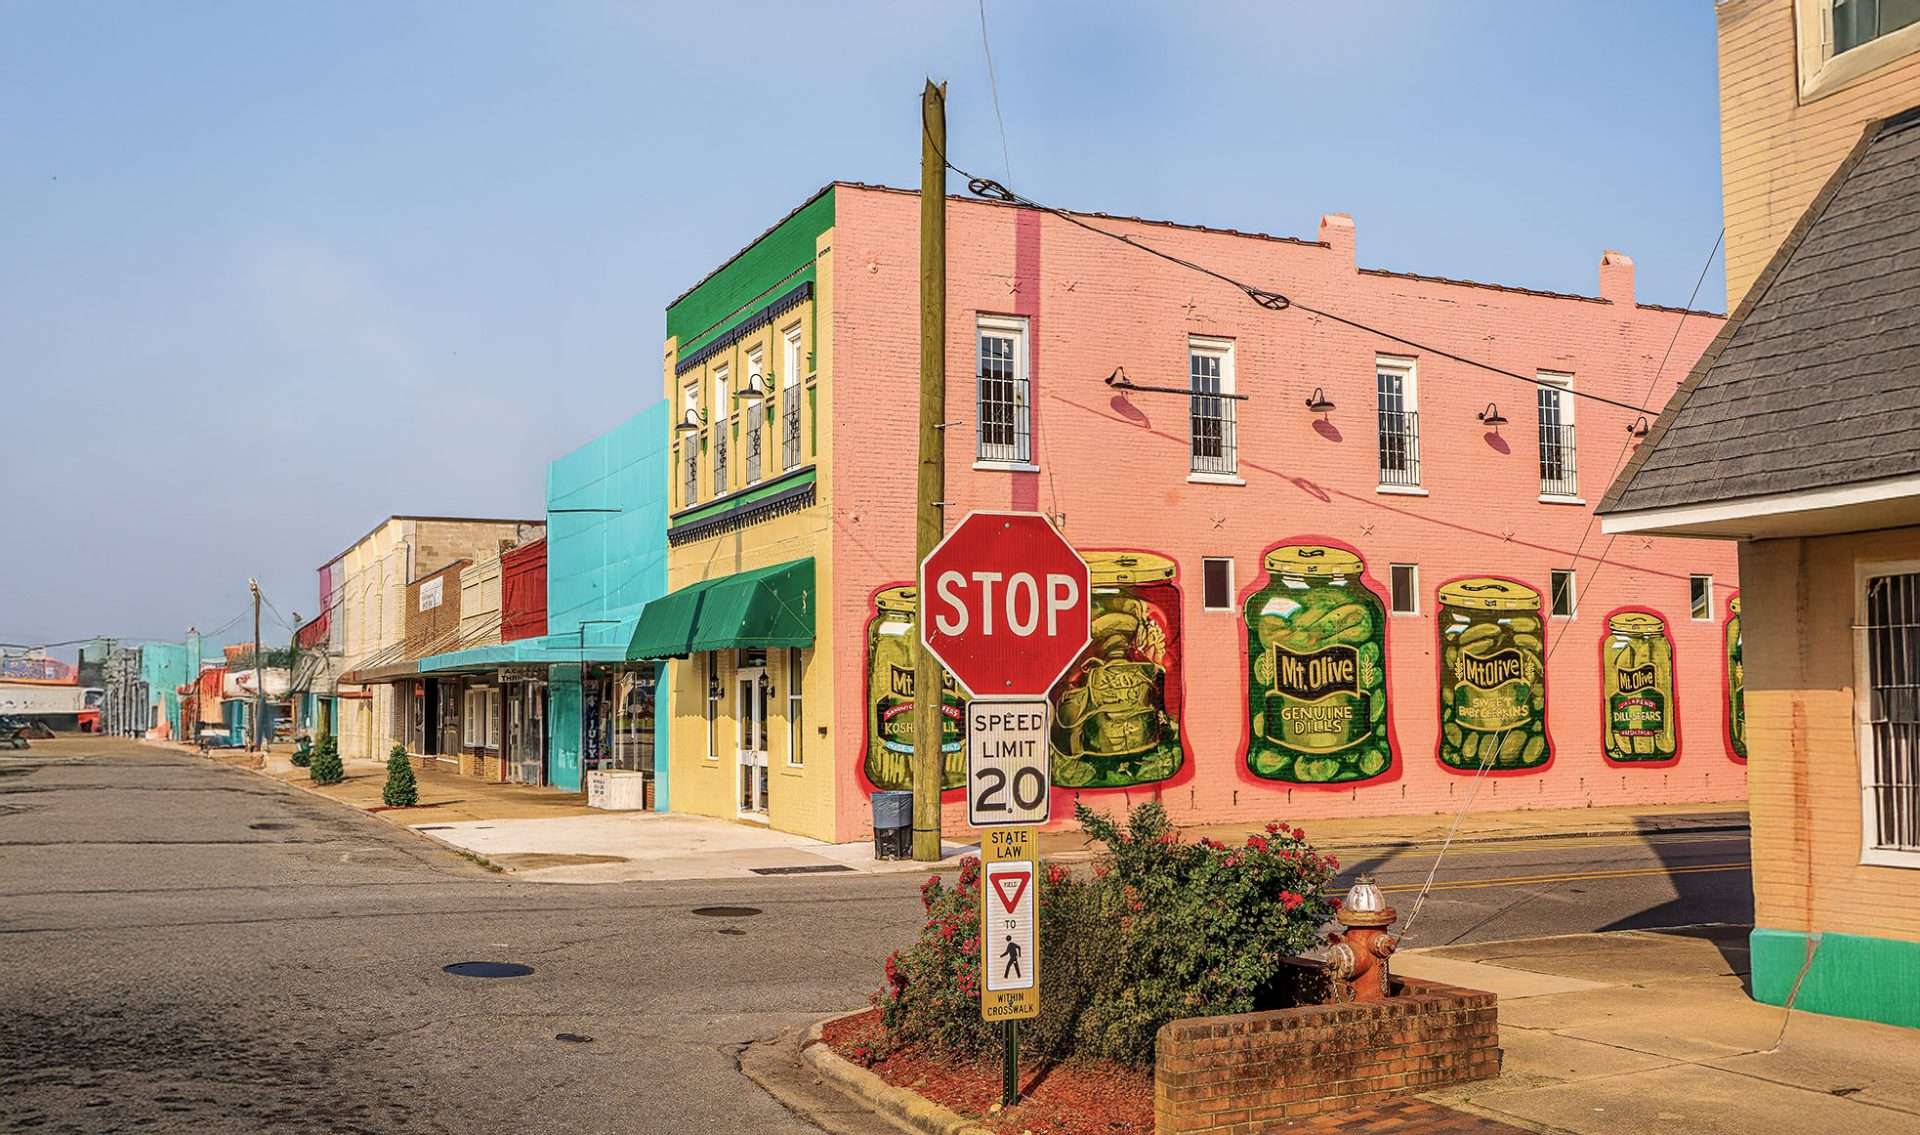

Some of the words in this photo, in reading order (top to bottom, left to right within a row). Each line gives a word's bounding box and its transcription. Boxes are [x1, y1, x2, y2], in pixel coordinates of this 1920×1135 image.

[936, 571, 1079, 637] STOP
[1281, 656, 1308, 692] Mt.
[1309, 656, 1353, 689] Olive
[1486, 659, 1520, 686] Olive
[1633, 671, 1653, 688] Olive
[1281, 706, 1353, 721] GENUINE
[1613, 711, 1631, 721] DILL
[975, 713, 1042, 732] SPEED
[1295, 720, 1342, 735] DILLS
[983, 741, 1036, 758] LIMIT
[975, 766, 1045, 812] 20
[991, 831, 1028, 844] STATE
[996, 846, 1022, 859] LAW
[1005, 919, 1016, 929] TO
[997, 992, 1024, 1003] WITHIN
[987, 1004, 1034, 1017] CROSSWALK
